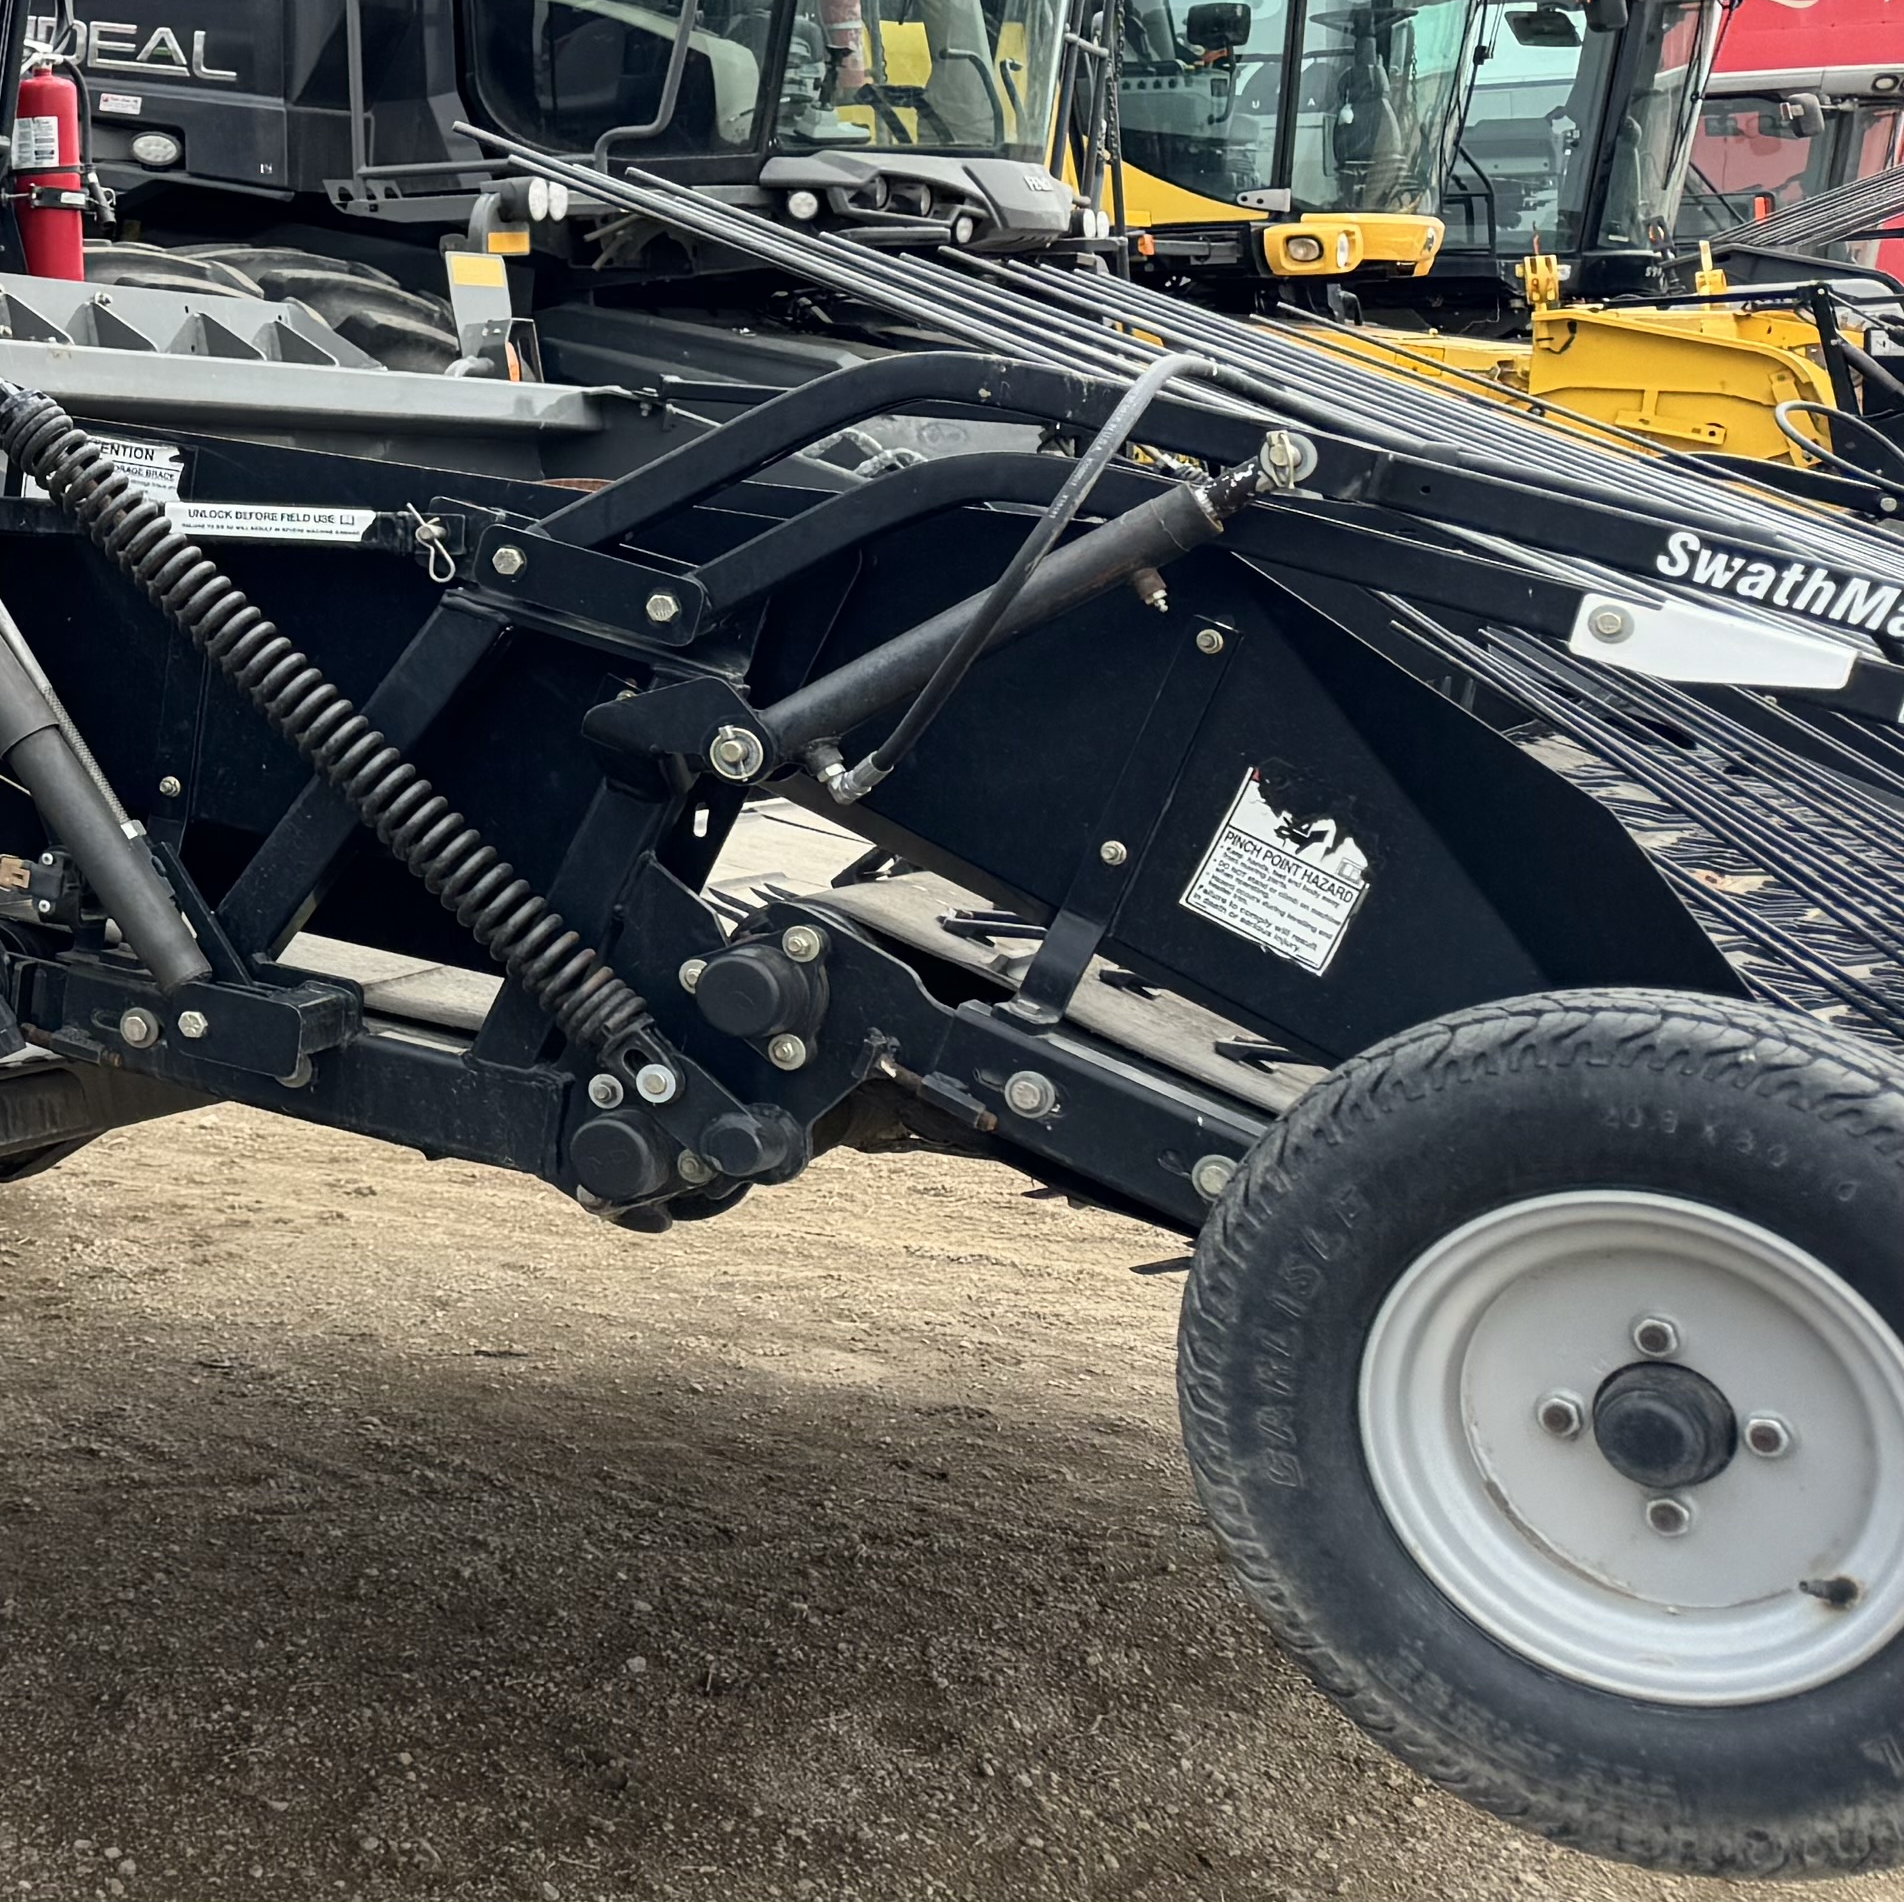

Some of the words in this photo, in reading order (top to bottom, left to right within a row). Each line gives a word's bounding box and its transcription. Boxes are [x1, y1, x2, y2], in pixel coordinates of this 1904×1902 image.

[188, 508, 232, 519] UNLOCK
[281, 513, 310, 522] FIELD
[313, 514, 335, 523] USE
[1223, 830, 1263, 857] PINCH
[1261, 849, 1302, 877] POINT
[1300, 869, 1354, 904] HAZARD
